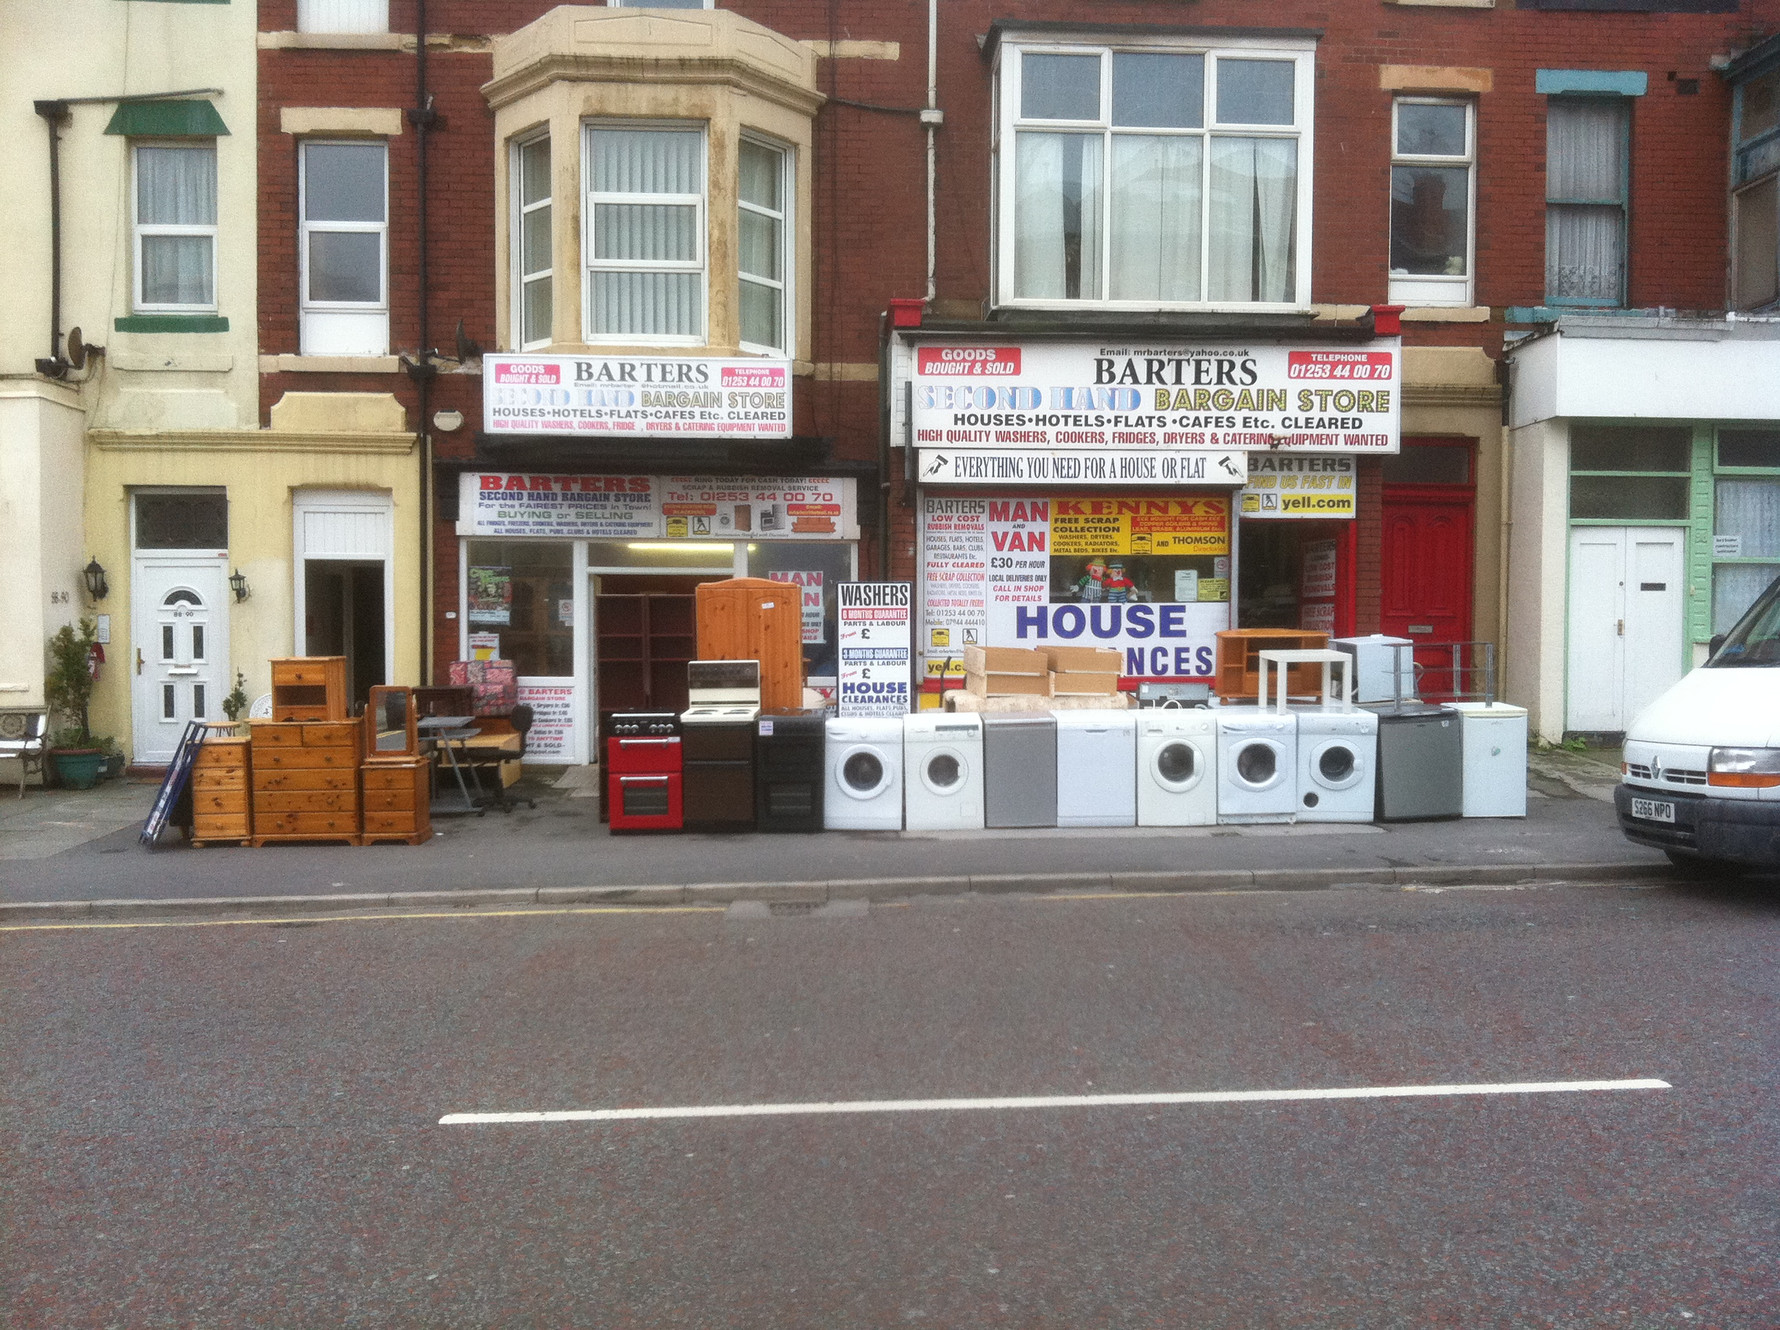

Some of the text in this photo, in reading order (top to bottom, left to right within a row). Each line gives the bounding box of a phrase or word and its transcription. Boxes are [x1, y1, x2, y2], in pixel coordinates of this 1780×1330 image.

[941, 349, 996, 361] GOODS
[1100, 348, 1130, 356] Email:
[1310, 353, 1368, 362] TELEPHONE
[510, 365, 545, 374] GOODS
[574, 361, 710, 384] BARTERS
[924, 361, 1015, 375] BOUGHT & SOLD
[1093, 357, 1258, 386] BARTERS
[1290, 364, 1390, 379] 01253 44 00 70
[500, 374, 557, 384] BOUGHT & SOLD
[722, 376, 784, 387] 01253 44 00 70
[641, 390, 723, 409] BARGAIN
[728, 391, 785, 410] STORE
[917, 385, 1390, 413] SECOND HAND BARGAIN STORE
[700, 410, 724, 421] Etc.
[727, 411, 786, 421] CLEARED
[493, 419, 510, 428] HIGH
[511, 420, 539, 431] QUALITY
[541, 420, 576, 430] WASHERS,
[578, 421, 611, 431] COOKERS,
[646, 421, 673, 431] DRYERS
[674, 422, 681, 431] &
[682, 422, 716, 432] CATERING
[717, 423, 756, 433] EQUIPMENT
[758, 424, 786, 433] WANTED
[1242, 416, 1275, 429] Etc.
[1280, 417, 1363, 430] CLEARED
[917, 429, 943, 442] HIGH
[946, 429, 991, 444] QUALITY
[994, 430, 1051, 445] WASHERS,
[1054, 431, 1109, 446] COOKERS,
[1111, 431, 1159, 446] FRIDGES,
[1163, 432, 1206, 445] DRYERS
[1210, 432, 1219, 445] &
[1222, 432, 1275, 446] CATERING
[1343, 434, 1388, 447] WANTED
[954, 456, 1207, 479] EVERYTHING YOU NEED FOR A HOUSE OR FLAT
[1247, 457, 1352, 473] BARTERS
[479, 475, 651, 493] BARTERS
[1246, 474, 1353, 489] FIND US FAST IN
[479, 491, 652, 503] SECOND HAND BARGAIN STORE
[667, 491, 834, 502] Tel: 01253 44 00 70
[926, 499, 986, 514] BARTERS
[1055, 500, 1226, 516] KENNYS
[1282, 496, 1352, 511] yell.com
[497, 511, 553, 519] BUYING
[575, 511, 634, 520] SELLING
[988, 501, 1049, 522] MAN
[932, 515, 981, 523] LOW COST
[927, 523, 985, 531] RUBBISH REMOVALS
[1053, 526, 1121, 534] COLLECTION
[990, 531, 1046, 552] VAN
[1172, 535, 1226, 545] THOMSON
[952, 561, 985, 569] CLEARED
[990, 557, 1046, 569] £30 PER HOUR
[770, 572, 823, 587] MAN
[988, 574, 1048, 583] LOCAL DELIVERIES ONLY
[840, 585, 909, 607] WASHERS
[936, 609, 957, 617] 01253
[957, 609, 966, 617] 44
[966, 609, 976, 617] 00
[977, 609, 985, 617] 70
[1015, 604, 1188, 639] HOUSE
[860, 628, 871, 640] £
[842, 648, 908, 660] 3 MONTHS GUARANTEE
[1126, 646, 1213, 677] NCES
[842, 682, 908, 694] HOUSE
[841, 694, 909, 704] CLEARANCES
